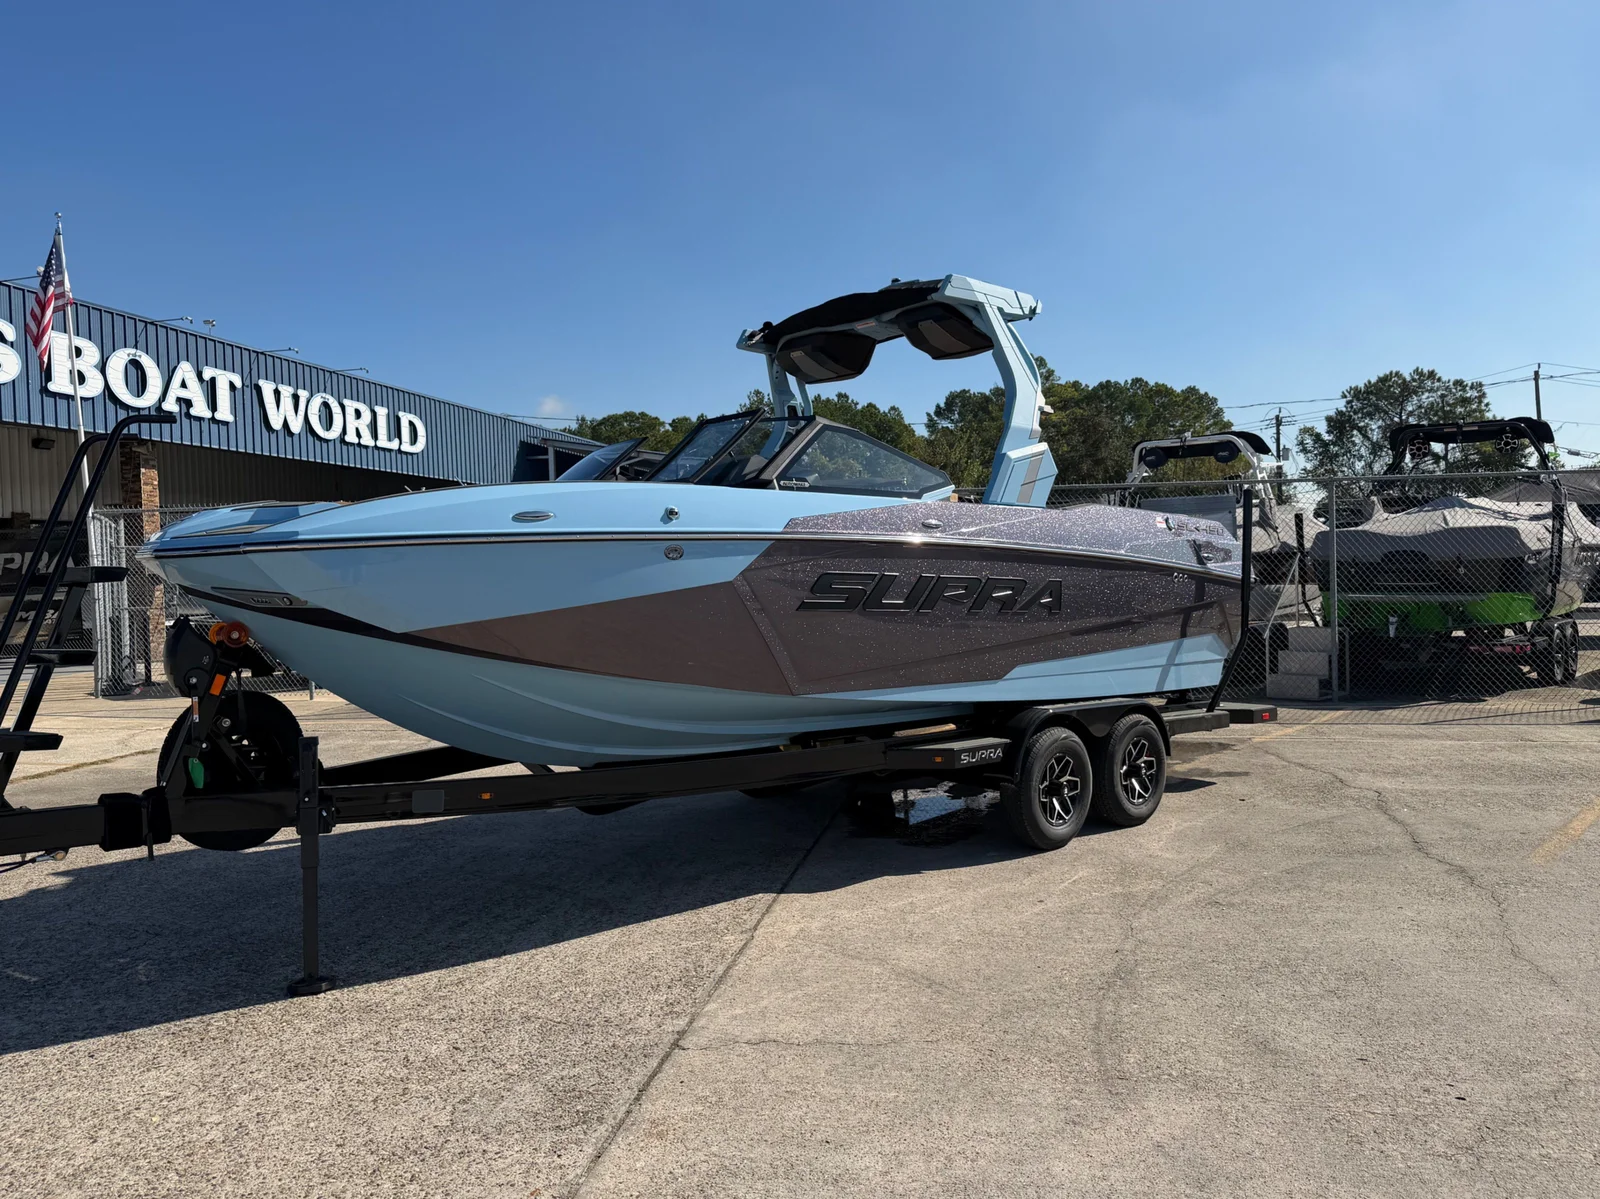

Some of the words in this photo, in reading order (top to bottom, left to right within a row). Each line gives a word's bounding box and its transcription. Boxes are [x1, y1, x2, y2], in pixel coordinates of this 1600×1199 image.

[47, 331, 242, 422] BOAT
[258, 379, 426, 454] WORLD
[796, 571, 1063, 613] SUPRA
[961, 748, 1003, 764] SUPRA
